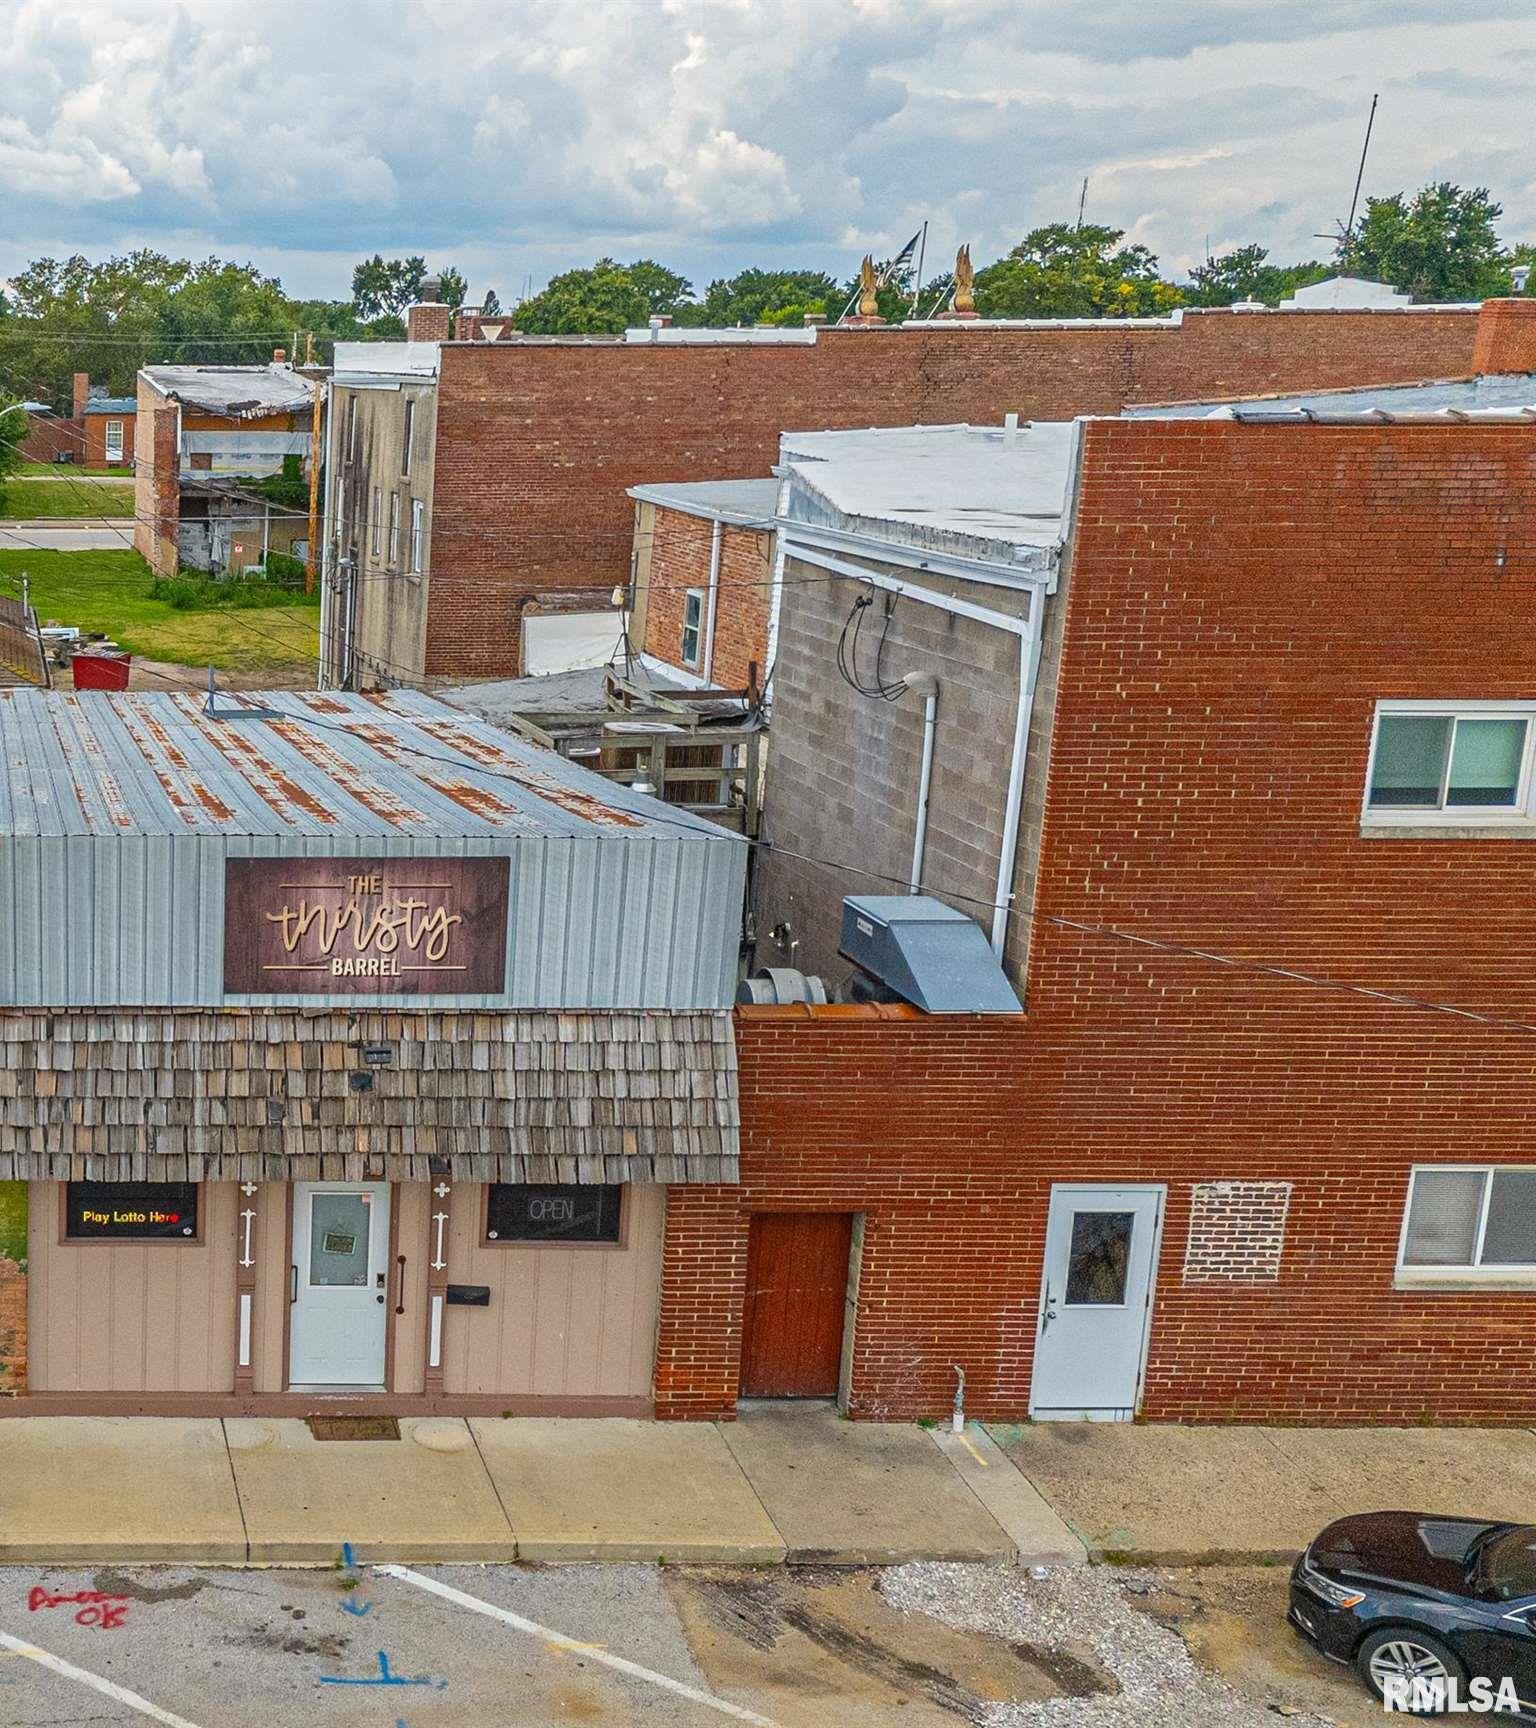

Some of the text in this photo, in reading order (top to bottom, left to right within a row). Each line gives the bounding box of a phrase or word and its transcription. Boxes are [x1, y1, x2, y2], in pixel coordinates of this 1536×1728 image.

[347, 875, 383, 895] THE
[266, 896, 462, 961] thirsty
[331, 957, 402, 977] BARREL
[83, 1210, 110, 1225] Play
[113, 1210, 146, 1223] Lotto
[530, 1199, 574, 1219] OPEN
[74, 1602, 129, 1630] OK
